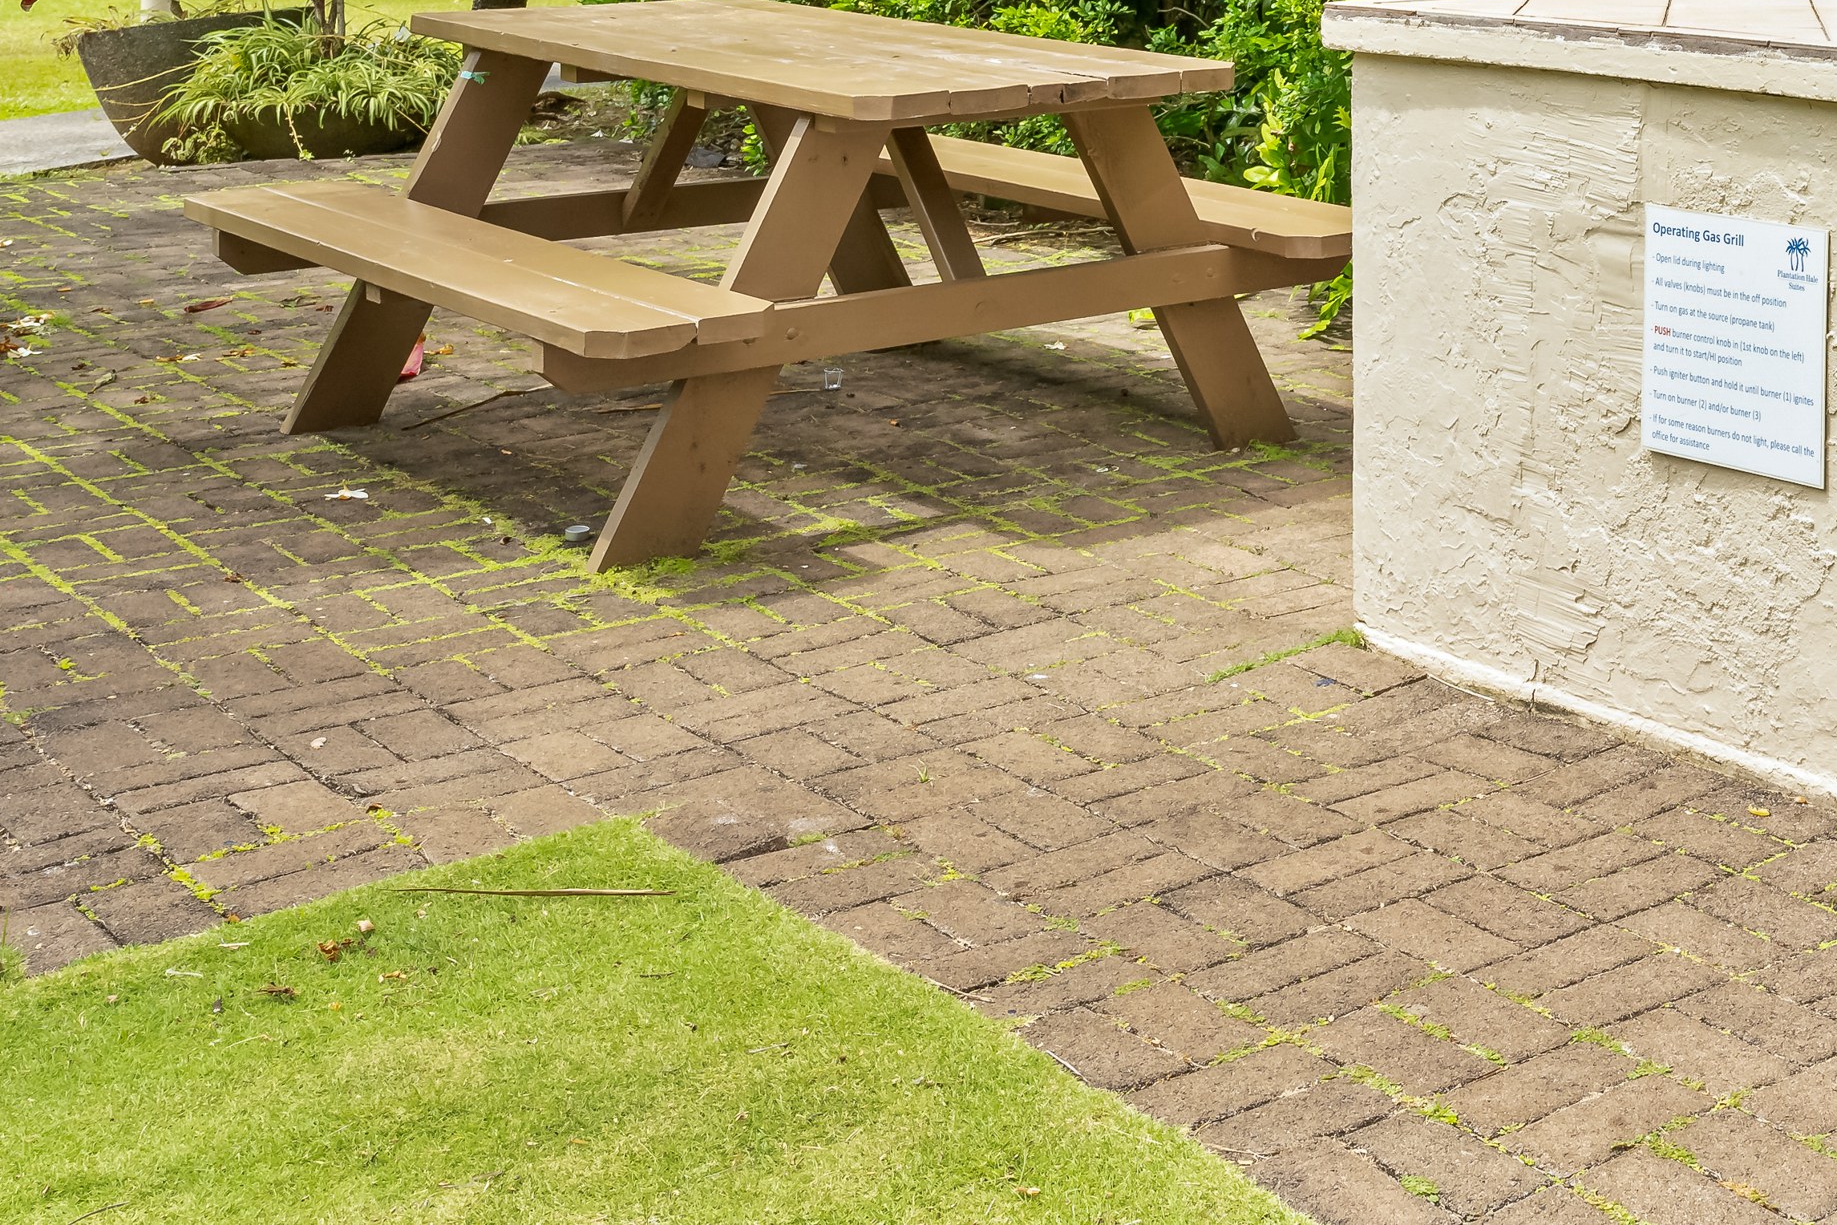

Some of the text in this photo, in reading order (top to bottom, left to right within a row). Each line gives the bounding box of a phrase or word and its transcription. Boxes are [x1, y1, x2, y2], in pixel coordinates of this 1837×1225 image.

[1653, 222, 1744, 246] Operating Gas Grill
[1656, 253, 1725, 274] Open lid during lighting
[1777, 270, 1818, 283] Plantation Hale
[1655, 277, 1663, 286] All
[1664, 279, 1682, 290] valves
[1683, 282, 1706, 295] (knobs)
[1707, 288, 1722, 297] must
[1723, 288, 1731, 298] be
[1739, 292, 1750, 302] the
[1751, 294, 1761, 303] off
[1761, 297, 1787, 307] position
[1788, 282, 1805, 291] Suites
[1655, 301, 1775, 332] Turn on gas at the source (propane tank)
[1653, 343, 1742, 366] and turn it to start/HI position
[1654, 325, 1671, 336] PUSH
[1672, 329, 1692, 340] burner
[1693, 335, 1715, 344] control
[1716, 337, 1731, 348] knob
[1739, 341, 1752, 352] (1st
[1753, 344, 1769, 355] knob
[1779, 349, 1790, 359] the
[1791, 351, 1804, 363] left)
[1653, 365, 1814, 406] Push igniter button and hold it until burner (1) ignites
[1653, 389, 1761, 422] Turn on burner (2) and/or burner (3)
[1652, 413, 1814, 457] If for some reason burners do not light, please call the
[1652, 430, 1710, 450] office for assistance
